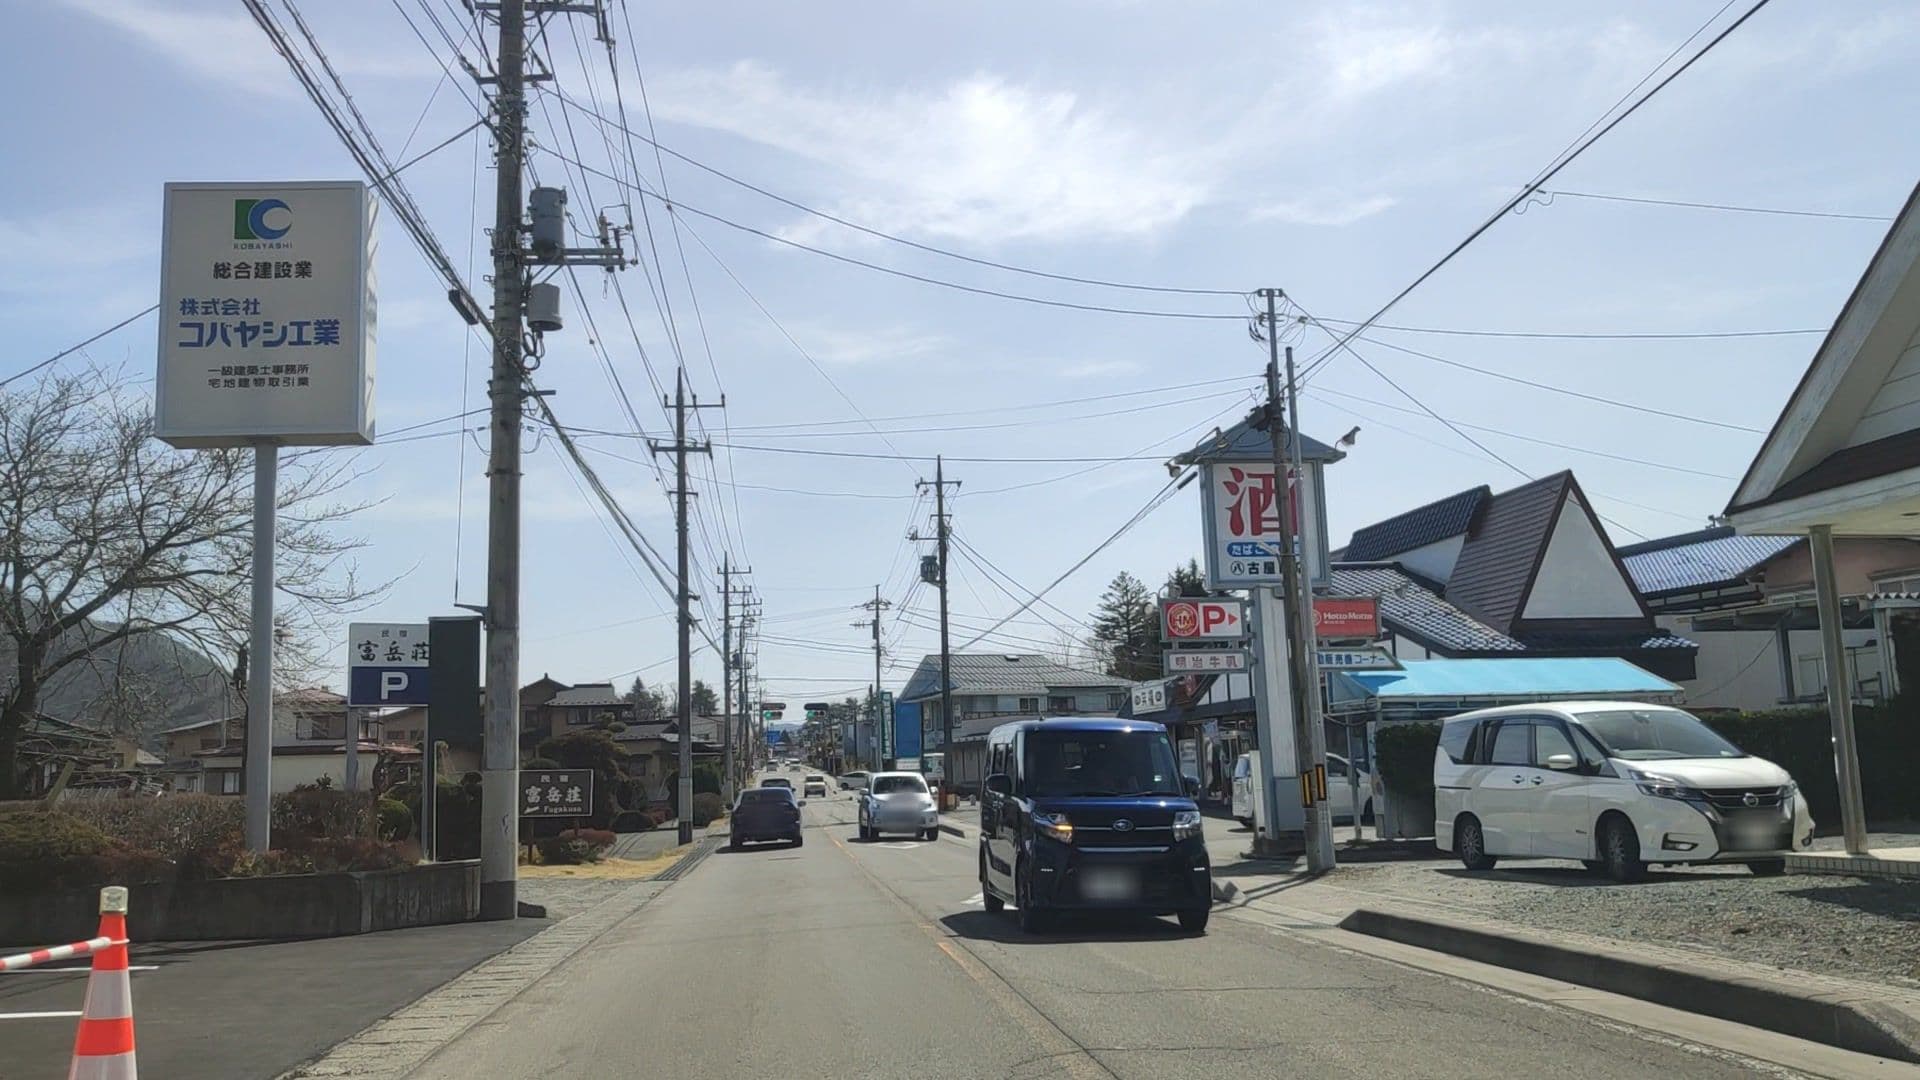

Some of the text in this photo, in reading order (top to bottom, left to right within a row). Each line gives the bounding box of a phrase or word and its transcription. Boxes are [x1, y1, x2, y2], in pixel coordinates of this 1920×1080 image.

[233, 242, 293, 250] KOBAYASHI
[213, 260, 313, 280] 総合建設業
[179, 298, 261, 316] 株式会社
[178, 319, 340, 348] コバヤシ工業
[208, 364, 309, 376] 一級建築士事務所
[208, 377, 309, 388] 宅地建物取引業
[1202, 605, 1226, 633] P
[357, 640, 430, 662] 富岳荘
[1175, 655, 1238, 668] 明治牛乳
[381, 671, 408, 700] P
[525, 785, 582, 803] 富岳荘
